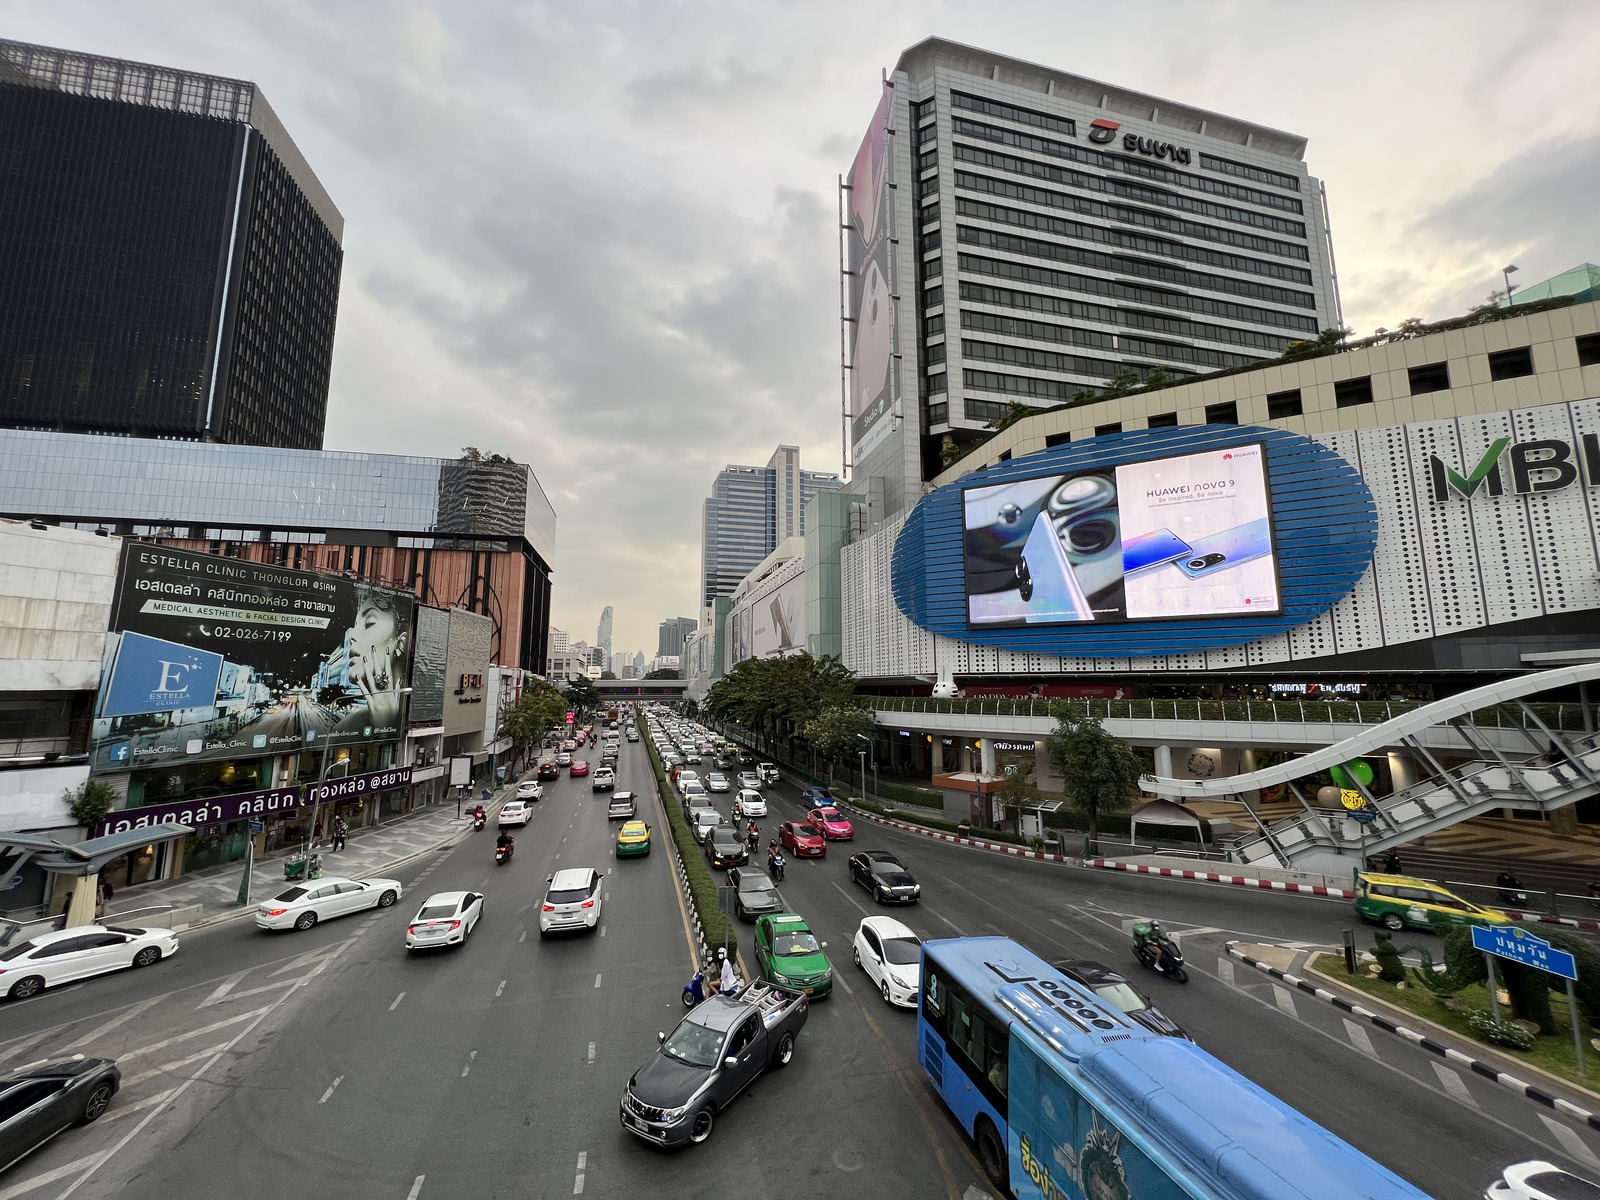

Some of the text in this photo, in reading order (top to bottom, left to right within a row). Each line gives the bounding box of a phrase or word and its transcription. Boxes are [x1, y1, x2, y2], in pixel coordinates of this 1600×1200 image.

[1123, 133, 1191, 164] ธนชาต
[1233, 451, 1258, 459] HUAWEI
[1430, 433, 1600, 502] MB
[1146, 479, 1235, 498] HUAWEI nova 9
[140, 553, 337, 593] ESTELLA CLINIC THONGLOR @SIAM
[135, 579, 336, 613] เอสเตลล่า คลินิกทองหล่อ สาขาสยาม
[153, 602, 193, 614] MEDICAL
[196, 608, 243, 619] AESTHETIC
[254, 613, 278, 622] FACIAL
[281, 614, 306, 624] DESIGN
[307, 617, 325, 626] CLINIC
[214, 626, 292, 642] 02-026-7199
[151, 660, 190, 693] E
[1334, 683, 1360, 693] SUSHI
[149, 692, 191, 700] ESTELLA
[133, 745, 178, 756] EstellaClinic
[205, 739, 248, 750] Estella_Clinic
[238, 793, 294, 815] คลินิก
[370, 770, 410, 789] @สยาม
[1495, 937, 1547, 960] ปทุมวัน
